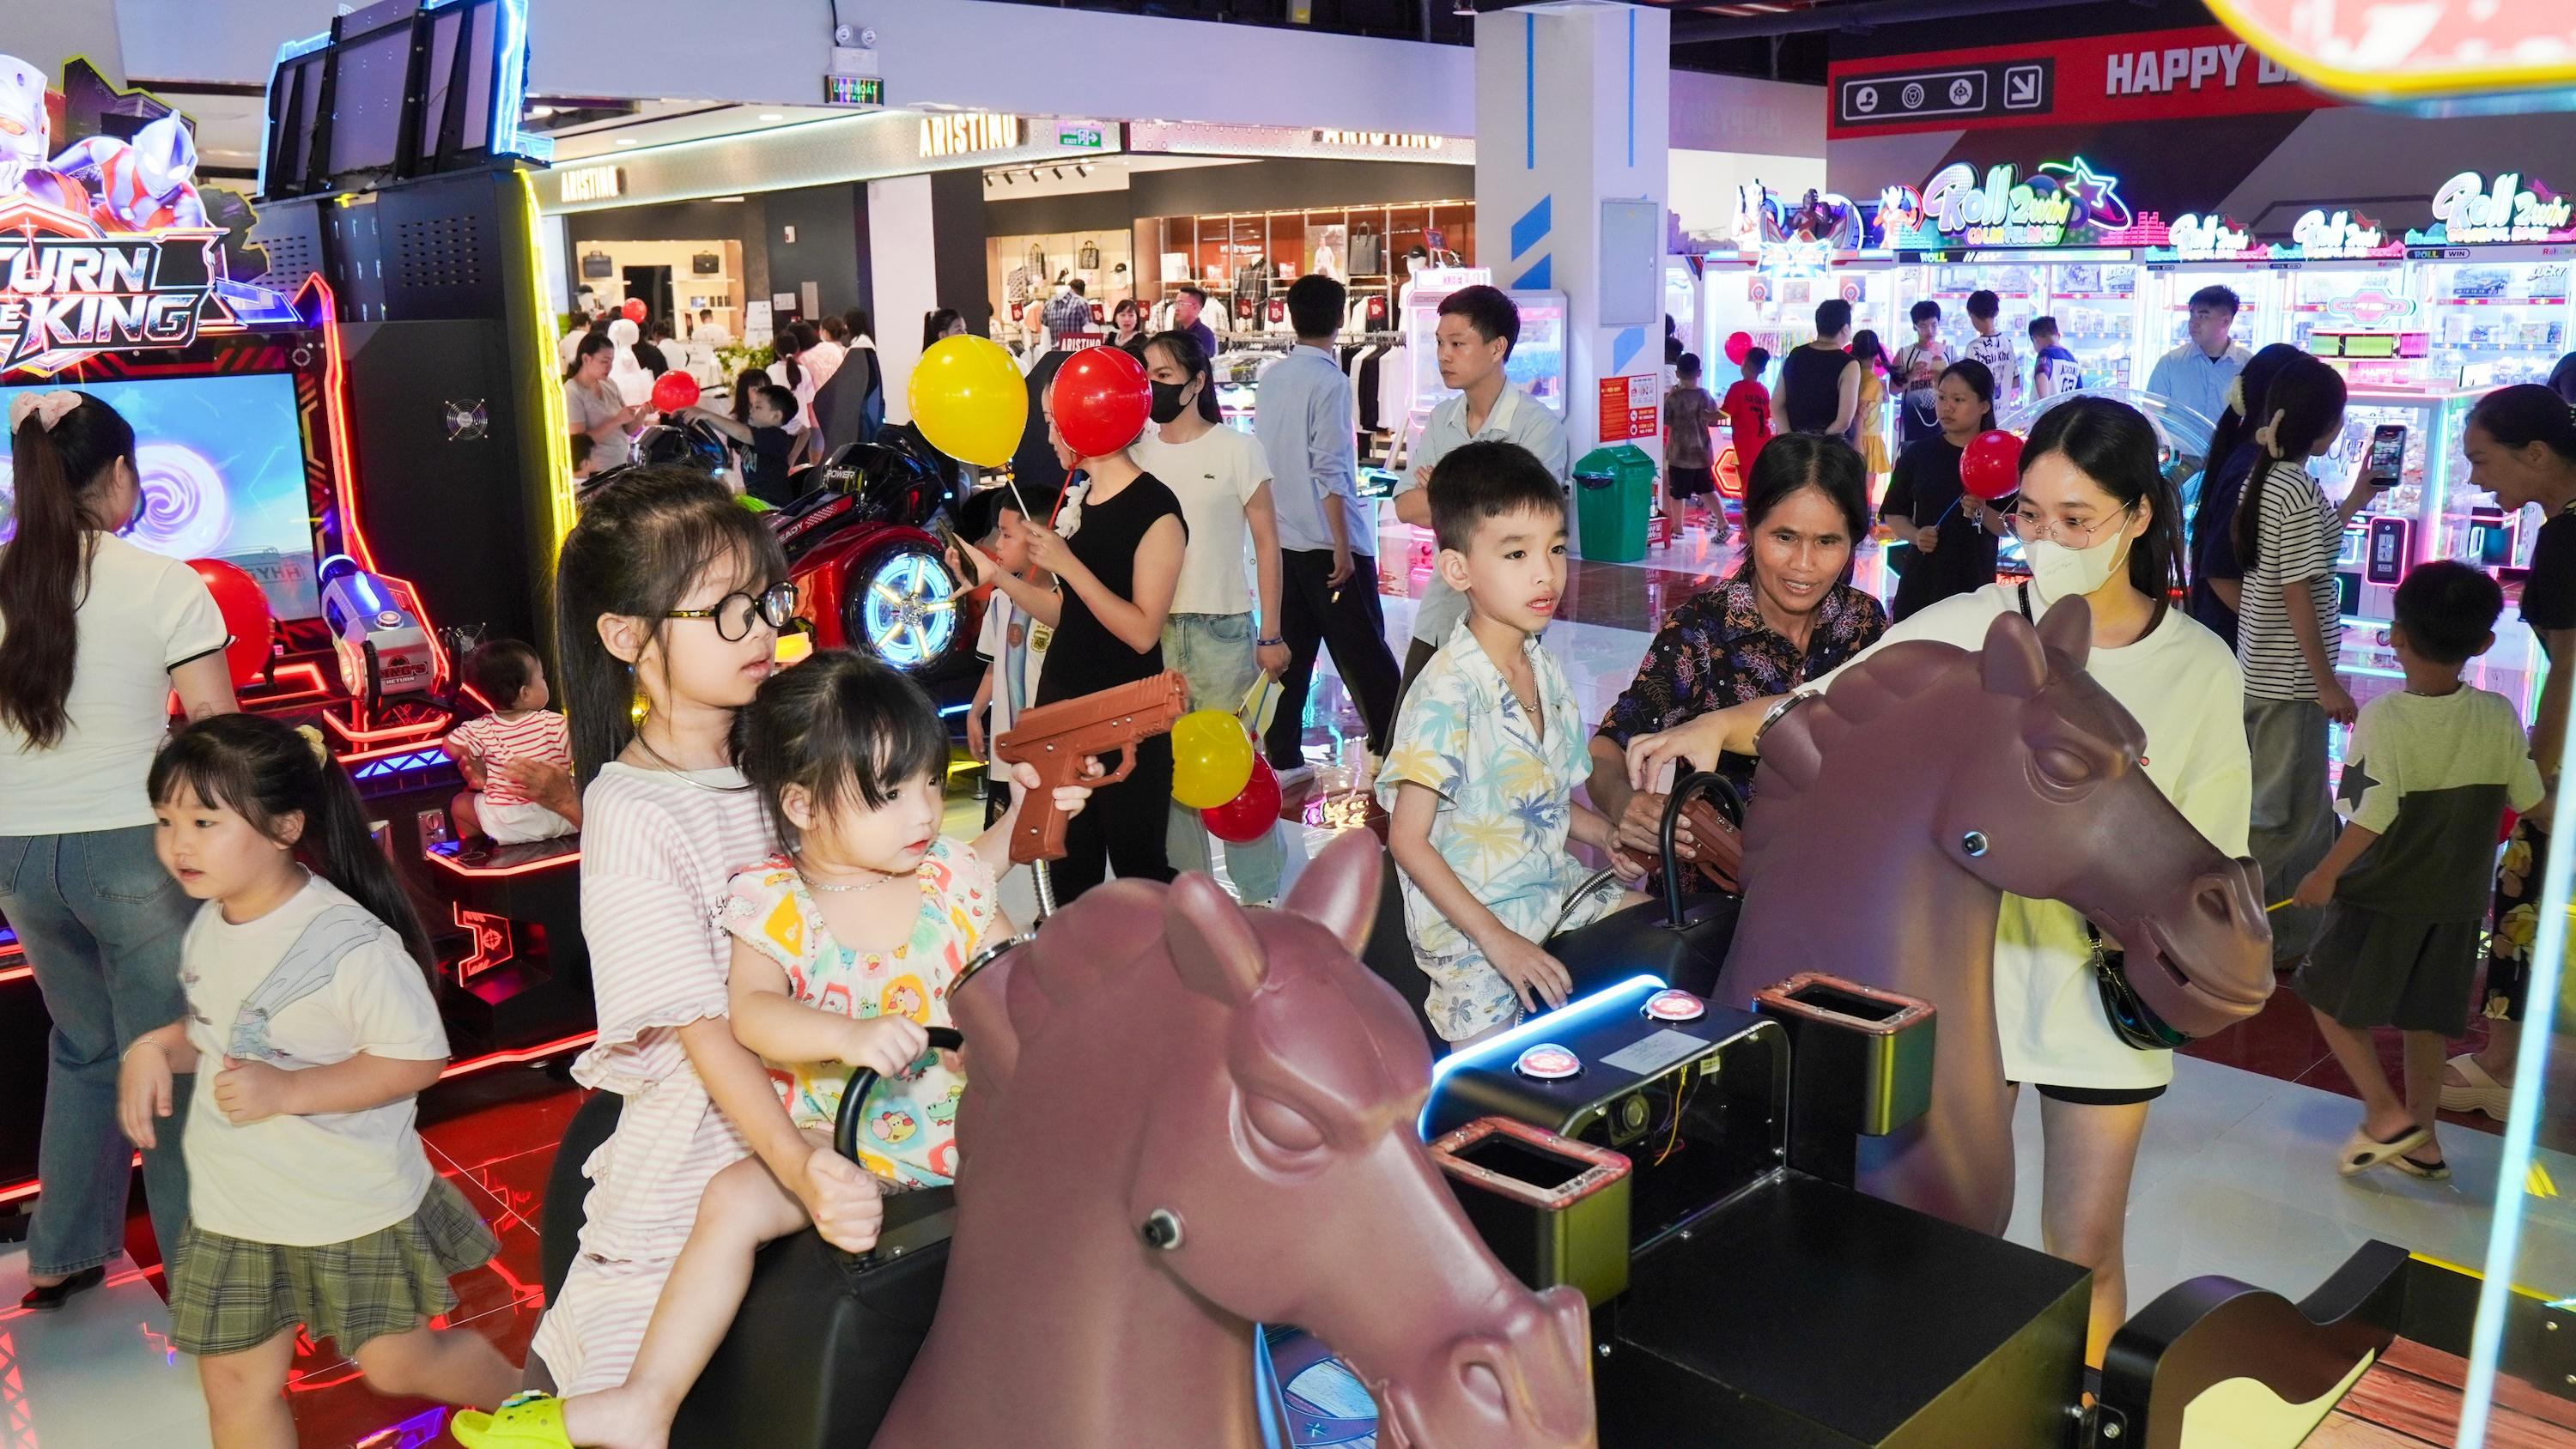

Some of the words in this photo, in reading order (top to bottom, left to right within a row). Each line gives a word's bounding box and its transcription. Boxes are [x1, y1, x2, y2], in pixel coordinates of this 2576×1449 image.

[2106, 43, 2247, 95] HAPPY
[919, 112, 1019, 159] ARISTINO
[1923, 162, 2014, 233] Roll
[2431, 171, 2519, 232] Roll
[0, 246, 150, 294] URN
[1919, 252, 1947, 264] ROLL
[2414, 250, 2439, 258] ROLL
[15, 294, 199, 360] KING
[776, 521, 804, 545] EADY
[386, 676, 416, 685] RETURN
